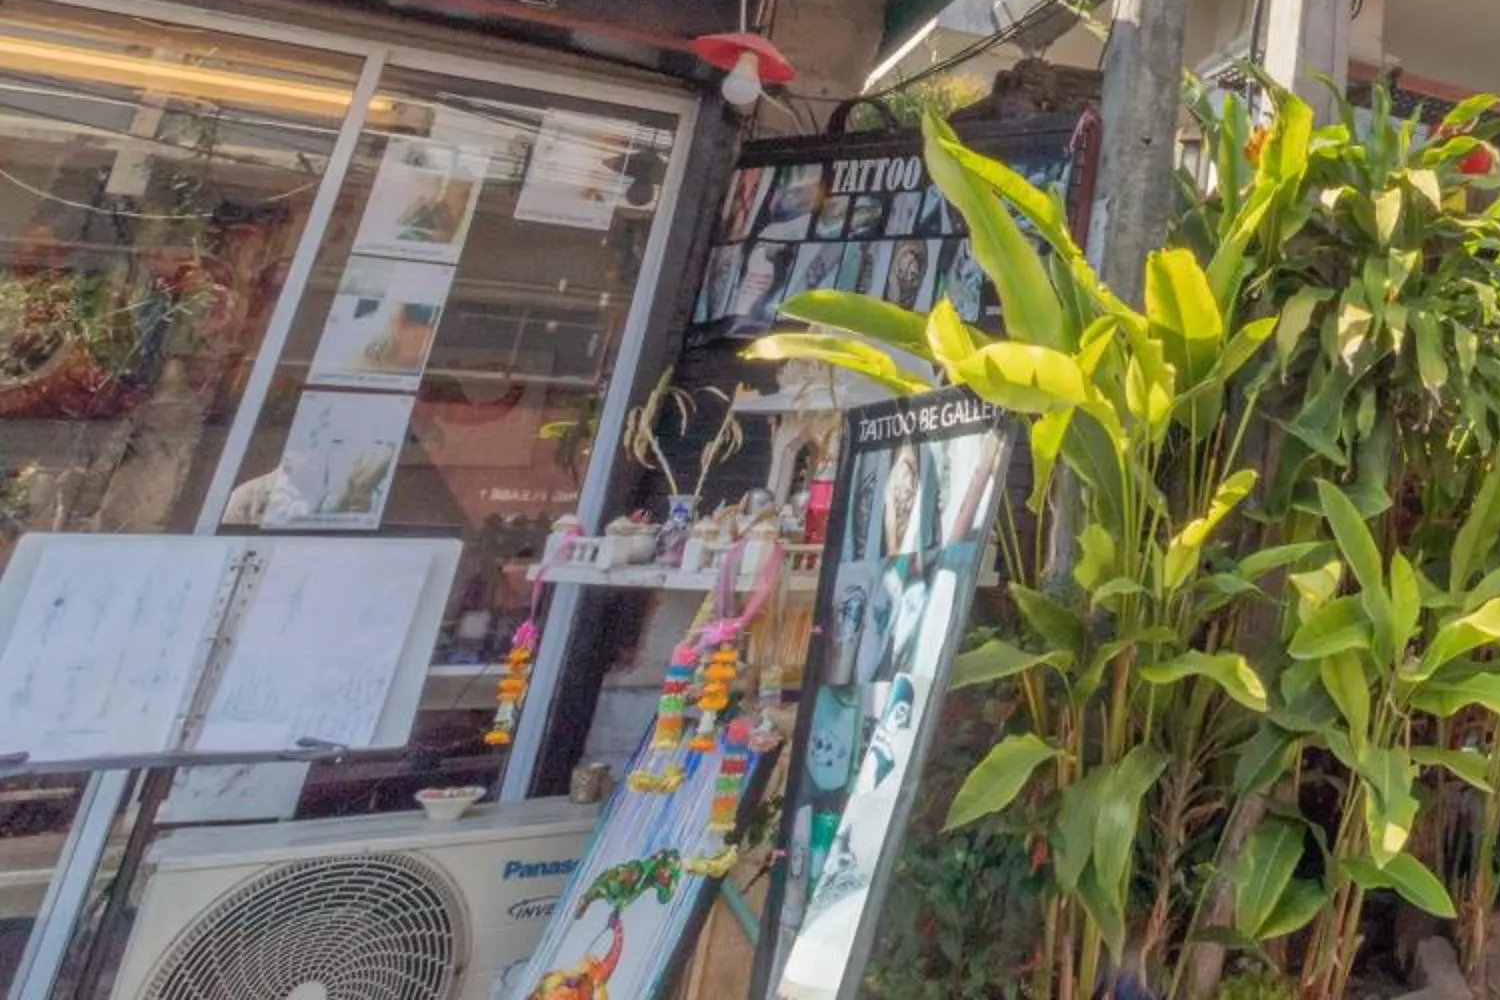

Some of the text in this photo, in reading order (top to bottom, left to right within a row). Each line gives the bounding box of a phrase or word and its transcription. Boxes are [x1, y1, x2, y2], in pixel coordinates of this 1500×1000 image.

[831, 156, 922, 194] TATTOO
[859, 397, 1006, 443] TATTOO BE GALLE
[503, 859, 582, 880] Panas
